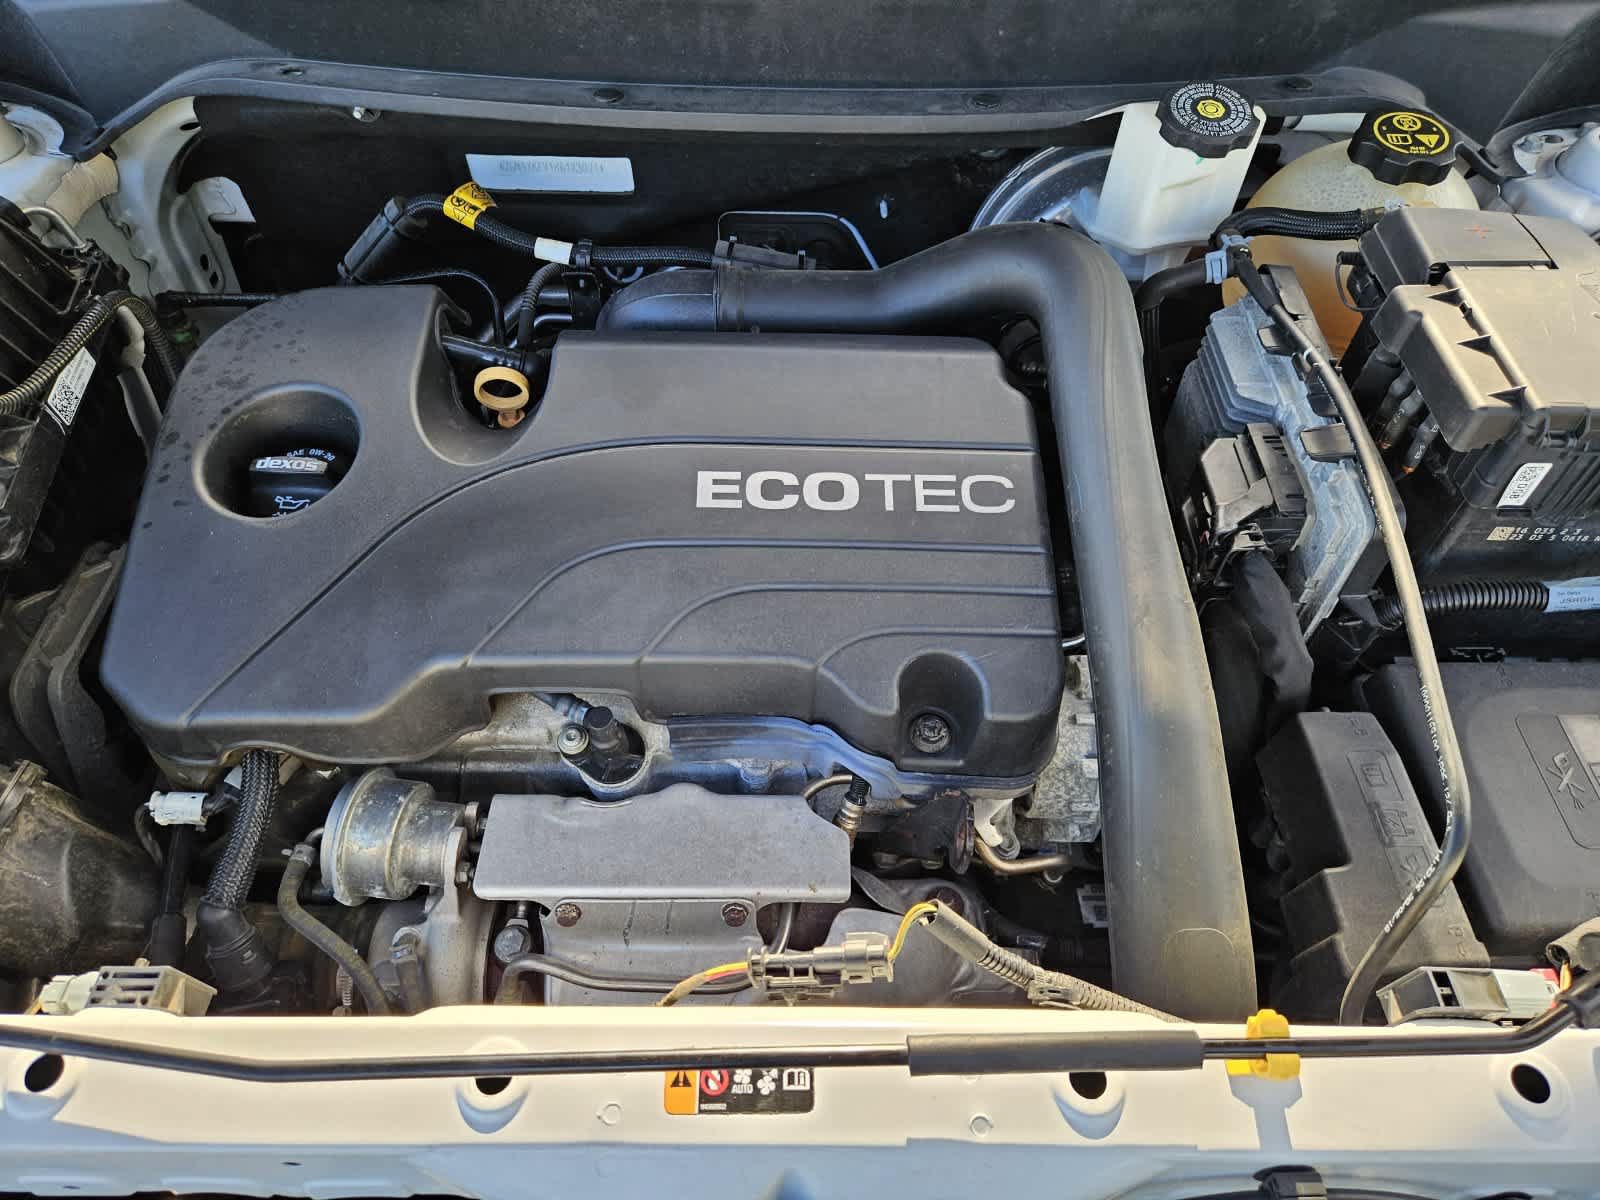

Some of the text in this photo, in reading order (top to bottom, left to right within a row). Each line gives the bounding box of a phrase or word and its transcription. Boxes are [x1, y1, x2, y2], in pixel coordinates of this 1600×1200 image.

[286, 449, 305, 458] SAE
[255, 456, 318, 472] dexos
[695, 470, 1016, 514] ECOTEC
[730, 1083, 754, 1095] AUTO
